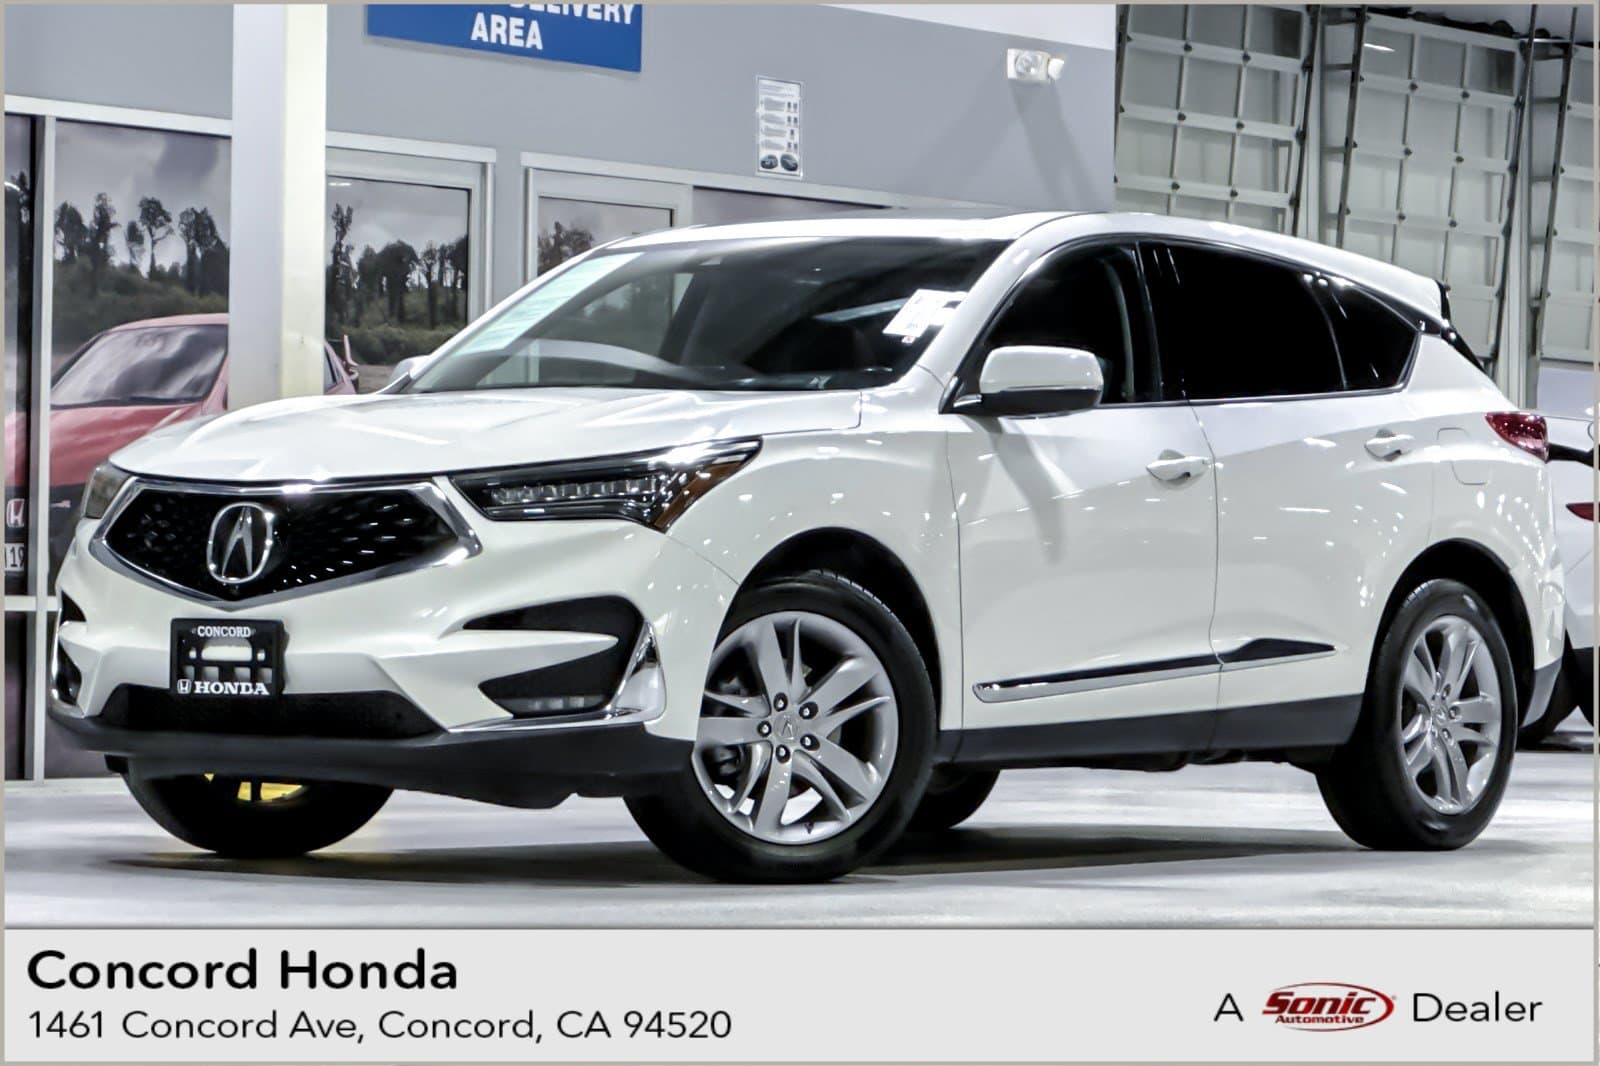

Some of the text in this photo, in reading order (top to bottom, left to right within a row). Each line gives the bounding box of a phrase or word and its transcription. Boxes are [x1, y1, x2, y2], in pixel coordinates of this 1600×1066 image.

[470, 12, 543, 50] AREA
[196, 625, 252, 638] CONCORD
[194, 680, 270, 696] HONDA
